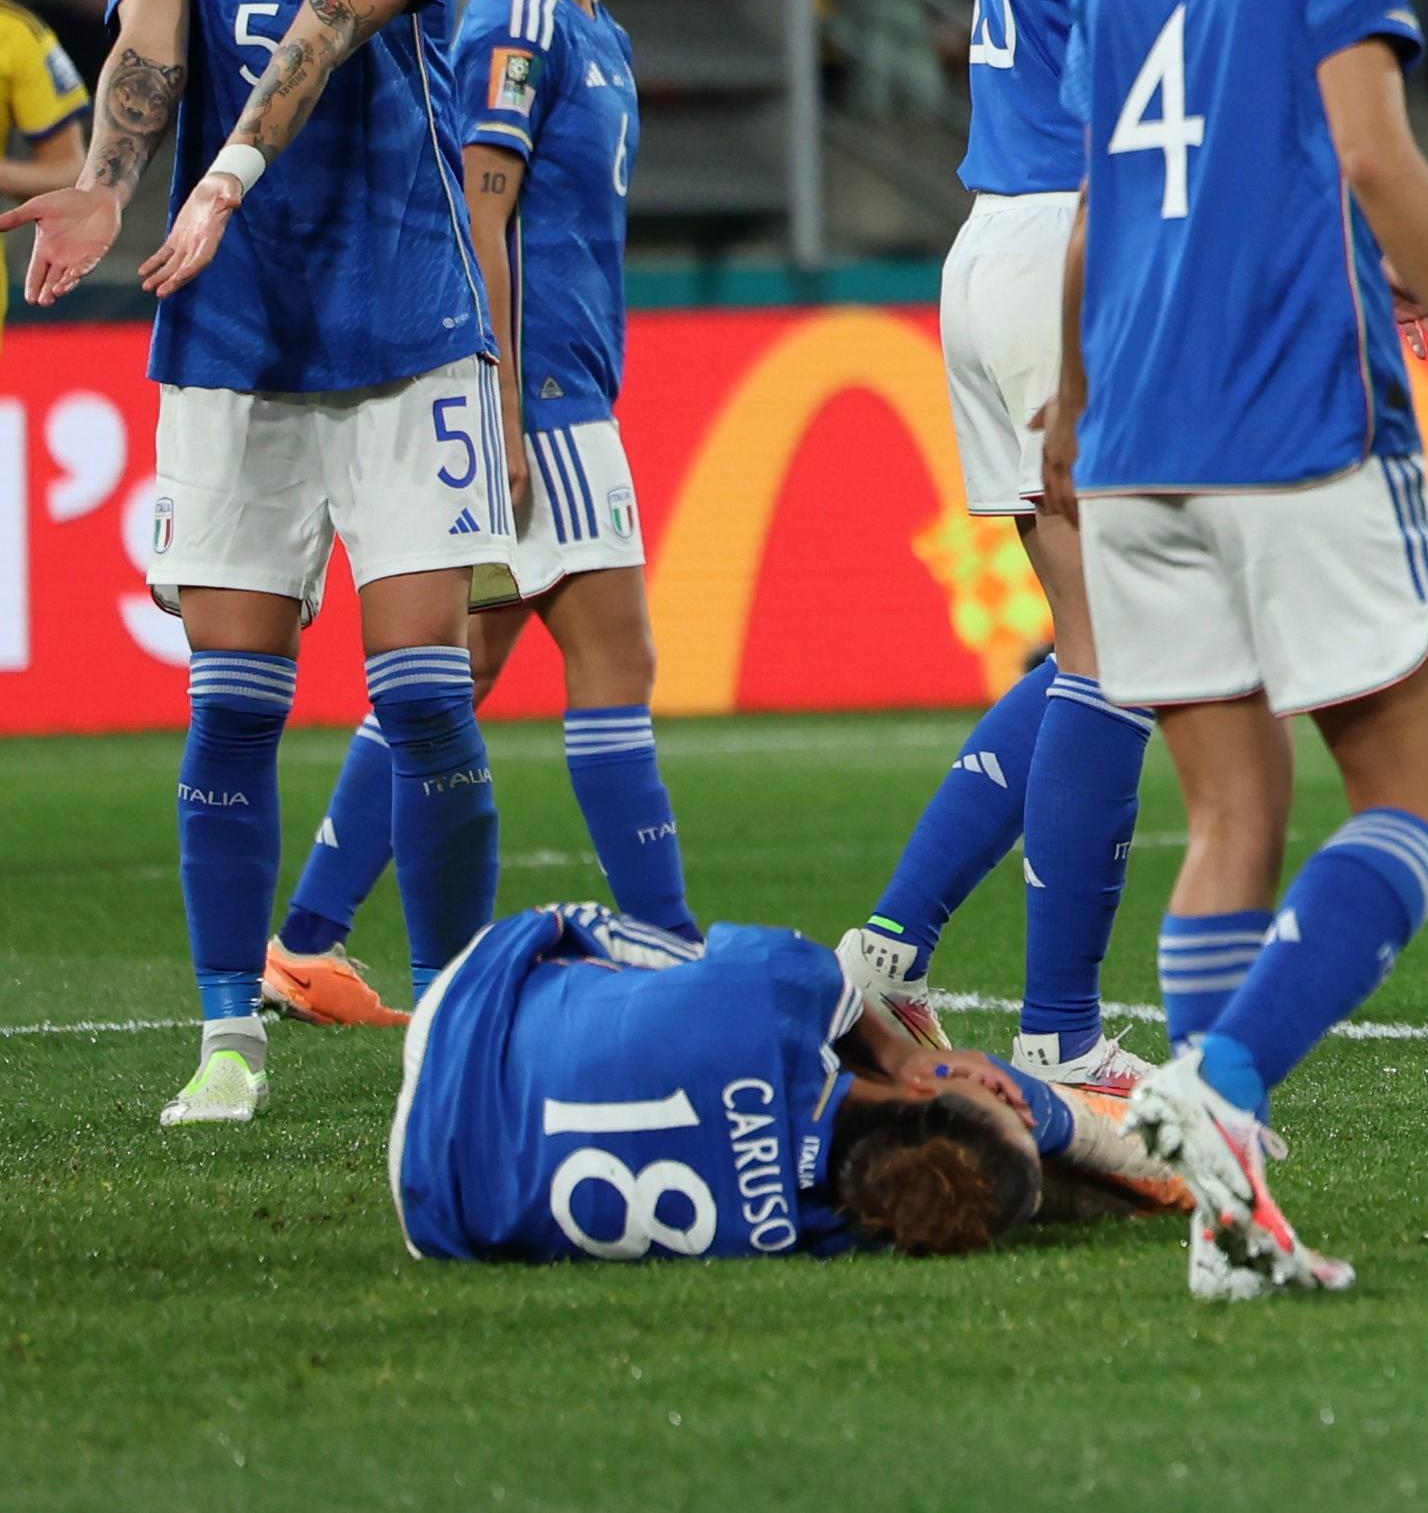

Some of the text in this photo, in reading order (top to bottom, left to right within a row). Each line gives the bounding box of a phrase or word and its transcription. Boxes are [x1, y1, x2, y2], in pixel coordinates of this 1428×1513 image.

[234, 3, 280, 87] 5
[1108, 3, 1204, 219] 4
[481, 171, 506, 194] 10
[432, 396, 478, 489] 5
[178, 782, 250, 806] ITALIA
[542, 1089, 718, 1261] 18
[721, 1077, 798, 1253] CARUSO
